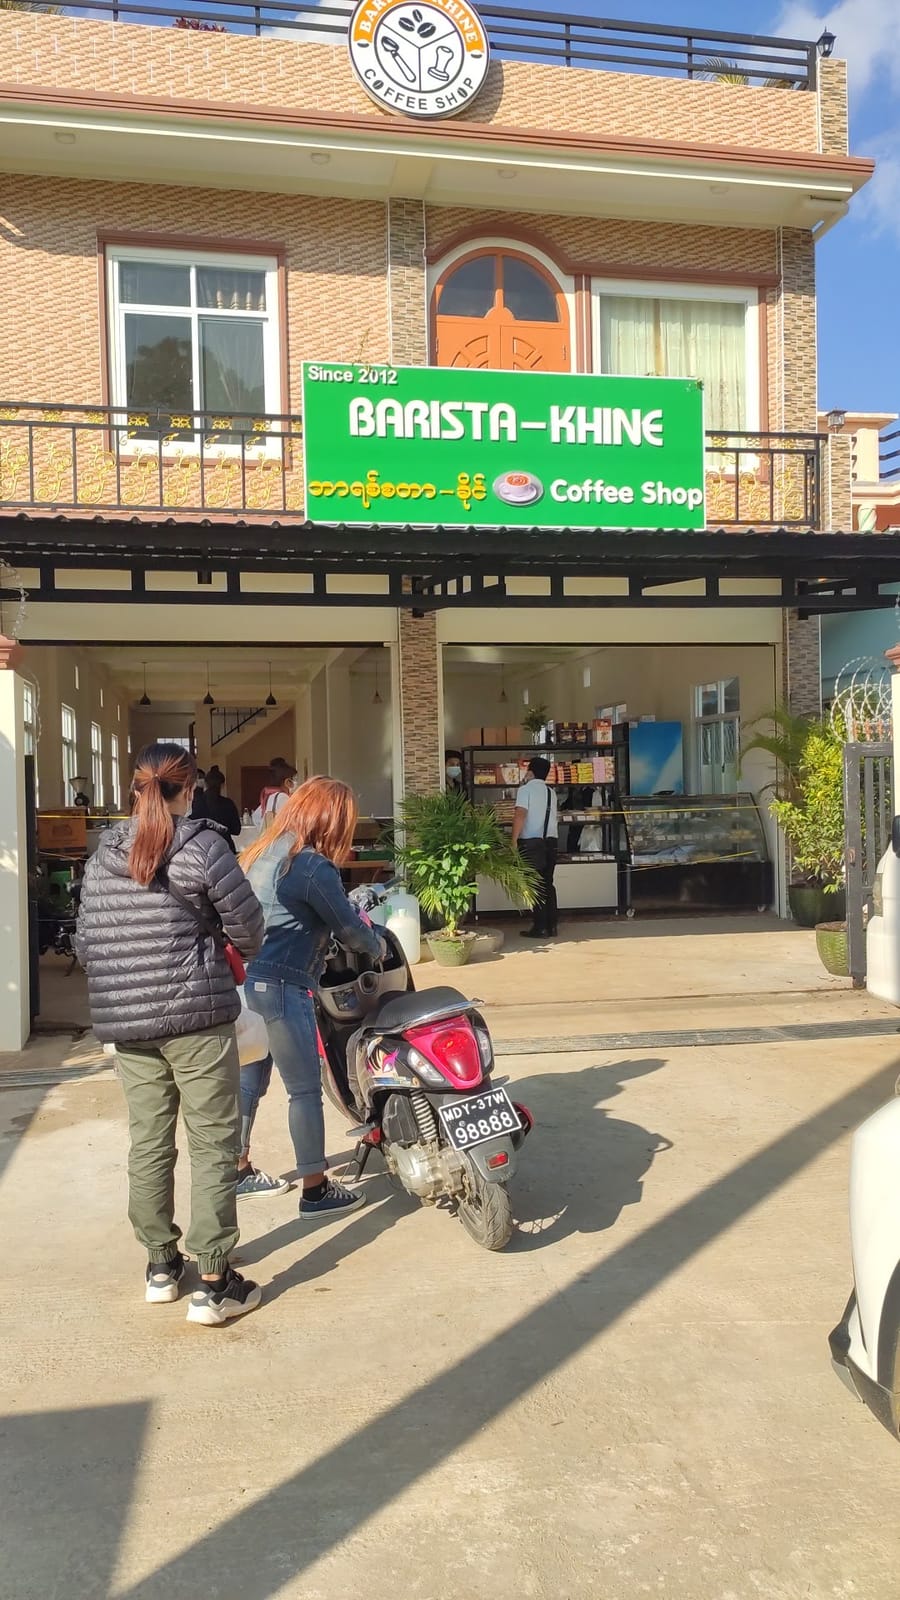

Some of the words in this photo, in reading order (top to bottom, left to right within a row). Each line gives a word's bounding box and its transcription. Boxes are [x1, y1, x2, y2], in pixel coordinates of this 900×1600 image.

[364, 68, 428, 110] COFFEE
[435, 77, 474, 109] SHOP
[307, 365, 353, 382] Since
[358, 368, 398, 385] 2012
[550, 478, 634, 504] Coffee
[641, 481, 703, 511] Shop
[443, 1091, 505, 1121] MDY-37W
[455, 1111, 513, 1143] 98888
